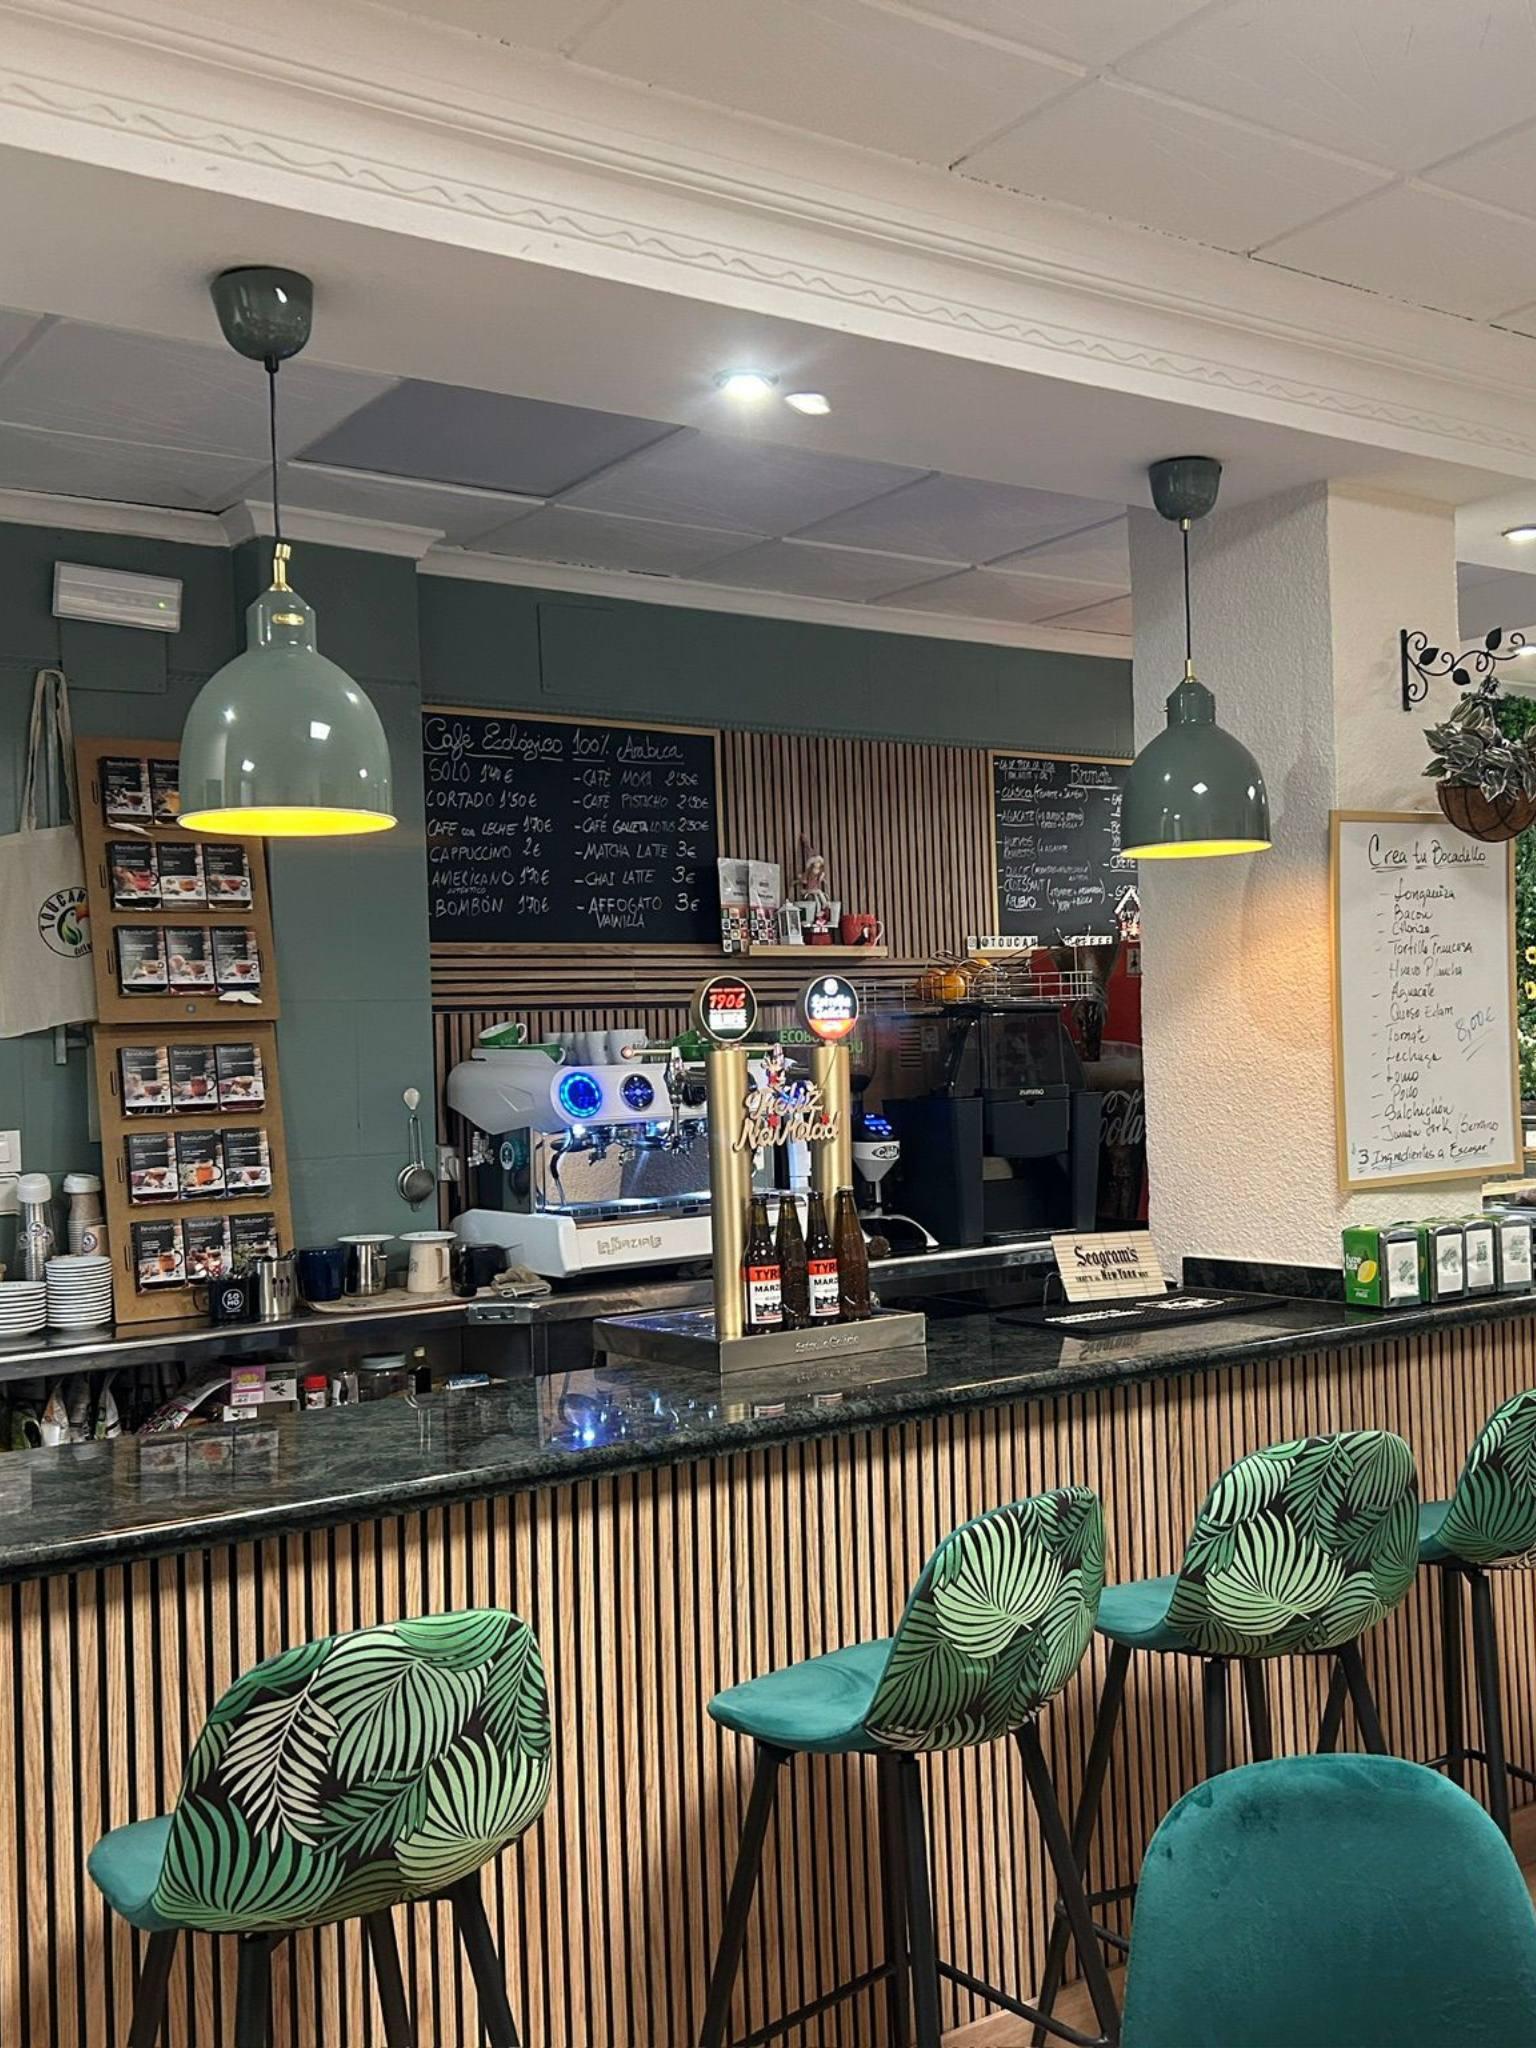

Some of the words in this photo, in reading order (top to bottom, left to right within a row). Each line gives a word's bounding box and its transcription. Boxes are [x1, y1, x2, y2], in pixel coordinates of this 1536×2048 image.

[425, 718, 475, 761] Café
[482, 722, 563, 761] Ecológico
[571, 728, 610, 755] 100%
[428, 758, 471, 783] SOLO
[426, 790, 495, 808] CORTADO
[482, 822, 518, 836] LECHE
[522, 837, 542, 858] 2€
[675, 841, 698, 859] 3€
[1368, 834, 1408, 868] Crea
[1413, 843, 1428, 864] tu
[1432, 839, 1487, 867] Bocadillo
[622, 869, 656, 885] LATTE
[672, 866, 696, 884] 3€
[41, 889, 86, 932] TOUCAN
[434, 895, 503, 918] BOMBÓN
[674, 893, 700, 912] 3€
[1393, 904, 1433, 922] Bacon
[710, 993, 745, 1008] 1906
[1019, 1088, 1044, 1097] zummo
[733, 1111, 841, 1152] Navidad
[1358, 1149, 1369, 1165] 3
[1074, 1245, 1139, 1268] Seagram's
[756, 1268, 780, 1281] TYR
[815, 1262, 838, 1274] TYR
